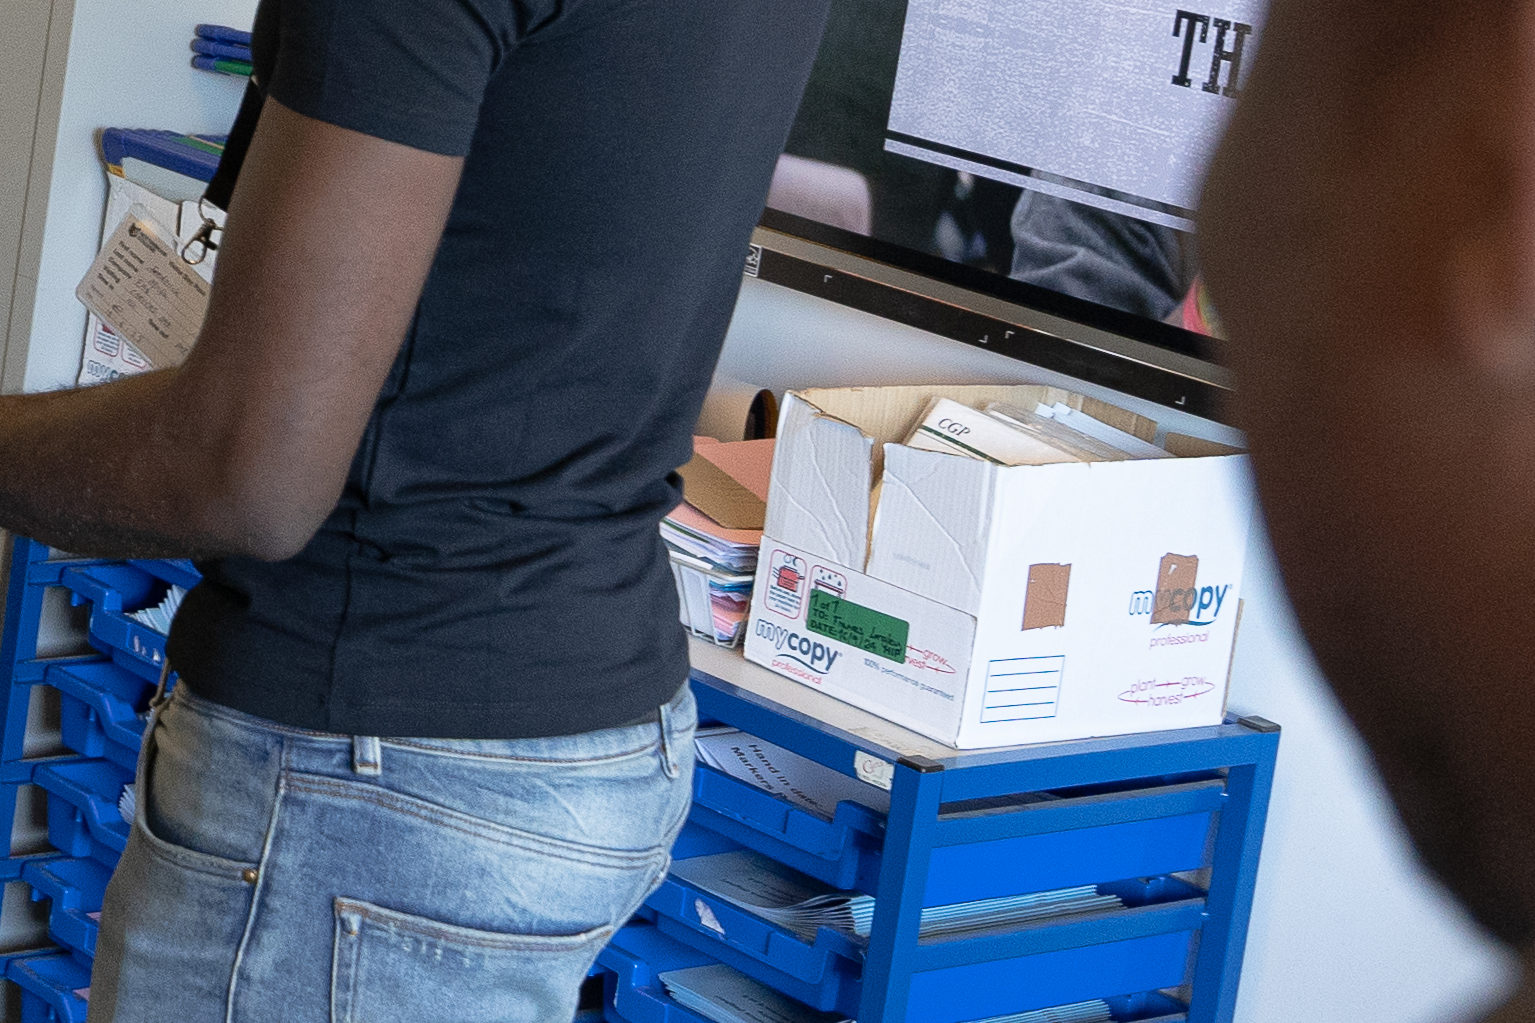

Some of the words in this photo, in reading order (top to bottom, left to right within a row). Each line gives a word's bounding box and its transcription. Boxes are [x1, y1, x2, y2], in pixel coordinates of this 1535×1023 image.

[937, 417, 972, 437] CGP
[755, 618, 838, 672] mycopy
[1149, 630, 1209, 650] professional
[922, 649, 948, 666] grow
[771, 658, 823, 685] professional
[1130, 678, 1156, 696] plant
[1181, 676, 1205, 691] grow
[1148, 691, 1184, 707] harvest
[730, 745, 774, 791] Markers
[748, 743, 779, 775] Hand
[777, 775, 791, 788] in
